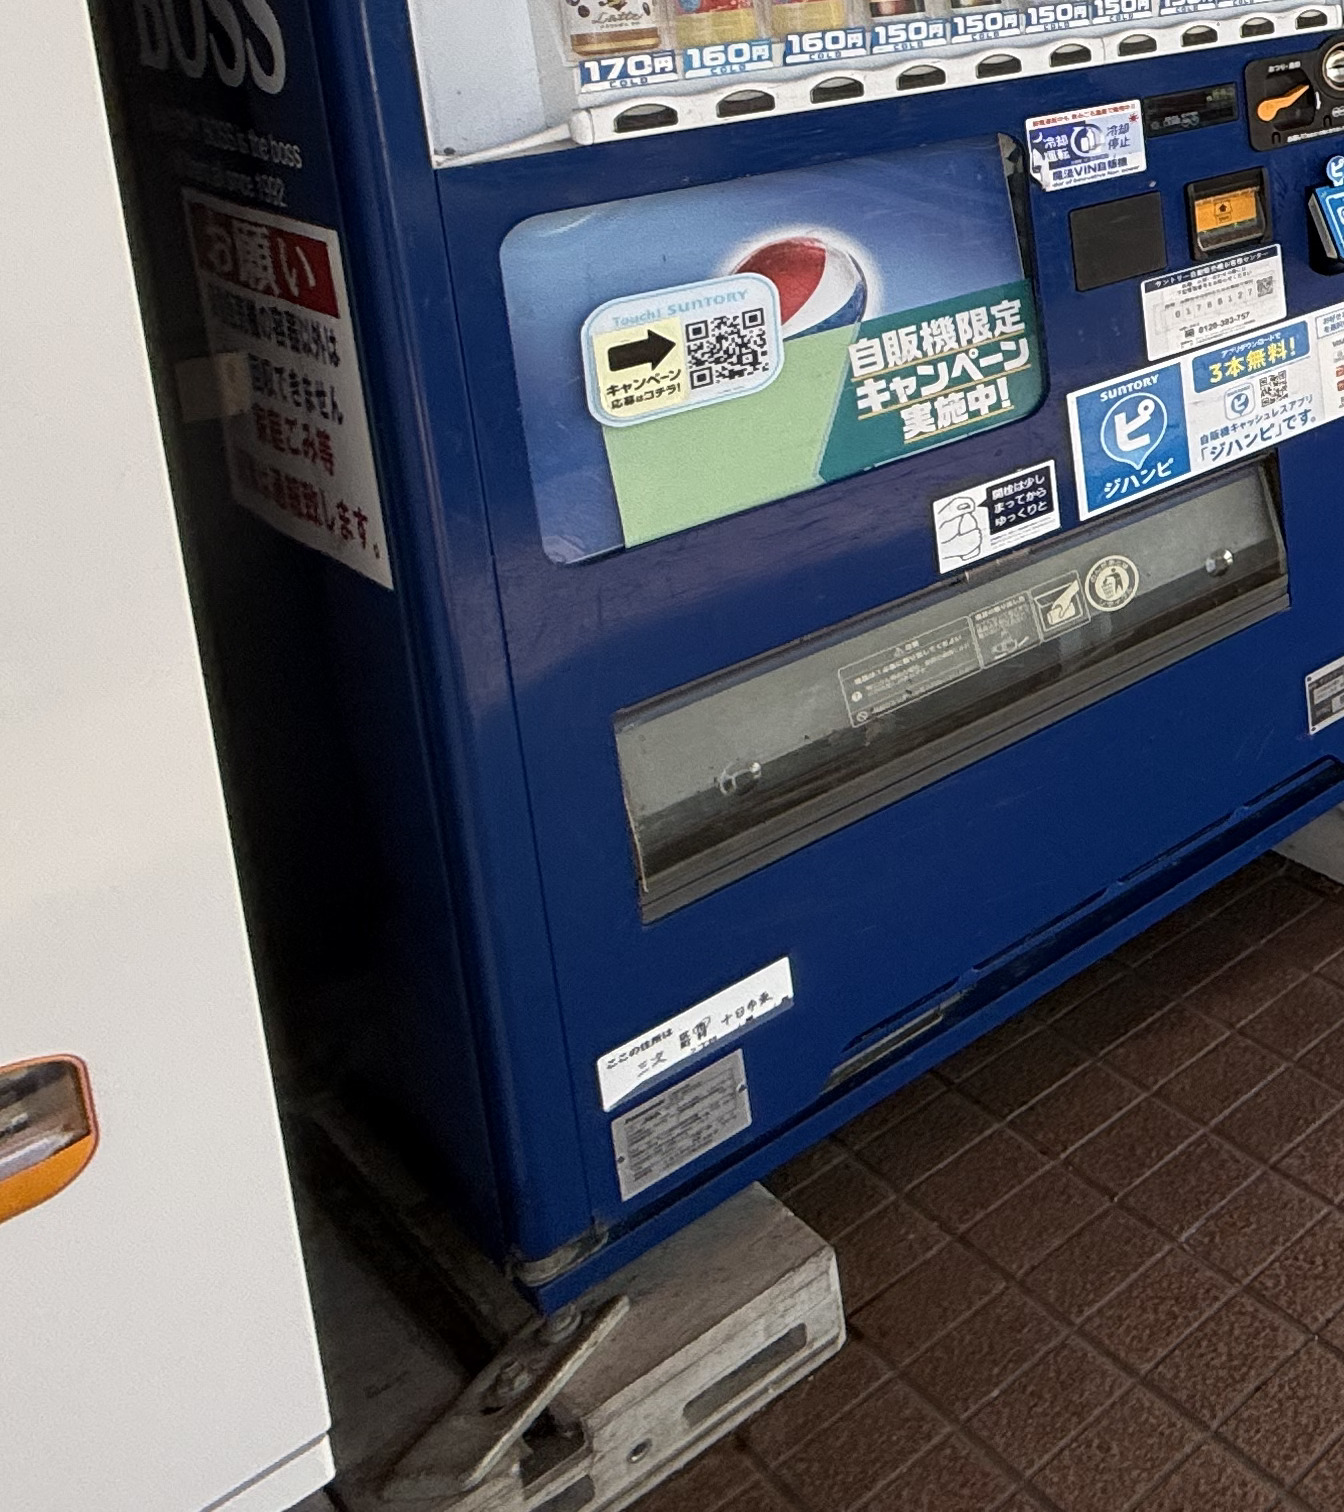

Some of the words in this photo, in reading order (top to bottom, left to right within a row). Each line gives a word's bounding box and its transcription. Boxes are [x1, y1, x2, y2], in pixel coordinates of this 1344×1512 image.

[953, 12, 1018, 34] 150円
[1027, 3, 1088, 24] 150円
[788, 29, 864, 53] 160円
[875, 21, 944, 45] 150円
[584, 52, 675, 81] 170円
[686, 43, 769, 70] 160円
[667, 290, 748, 317] SUNTORY
[848, 299, 1025, 375] 自販機限定
[1209, 337, 1296, 384] 3本無料!
[606, 368, 681, 397] キャンペーン
[857, 339, 1031, 416] キャンペーン
[1100, 374, 1160, 402] SUNTORY
[900, 379, 1011, 440] 実施中!
[1200, 394, 1313, 445] 自販機キャッシュレスアプリ
[1104, 457, 1175, 500] ジハンピ
[995, 501, 1048, 527] ゆっくりと
